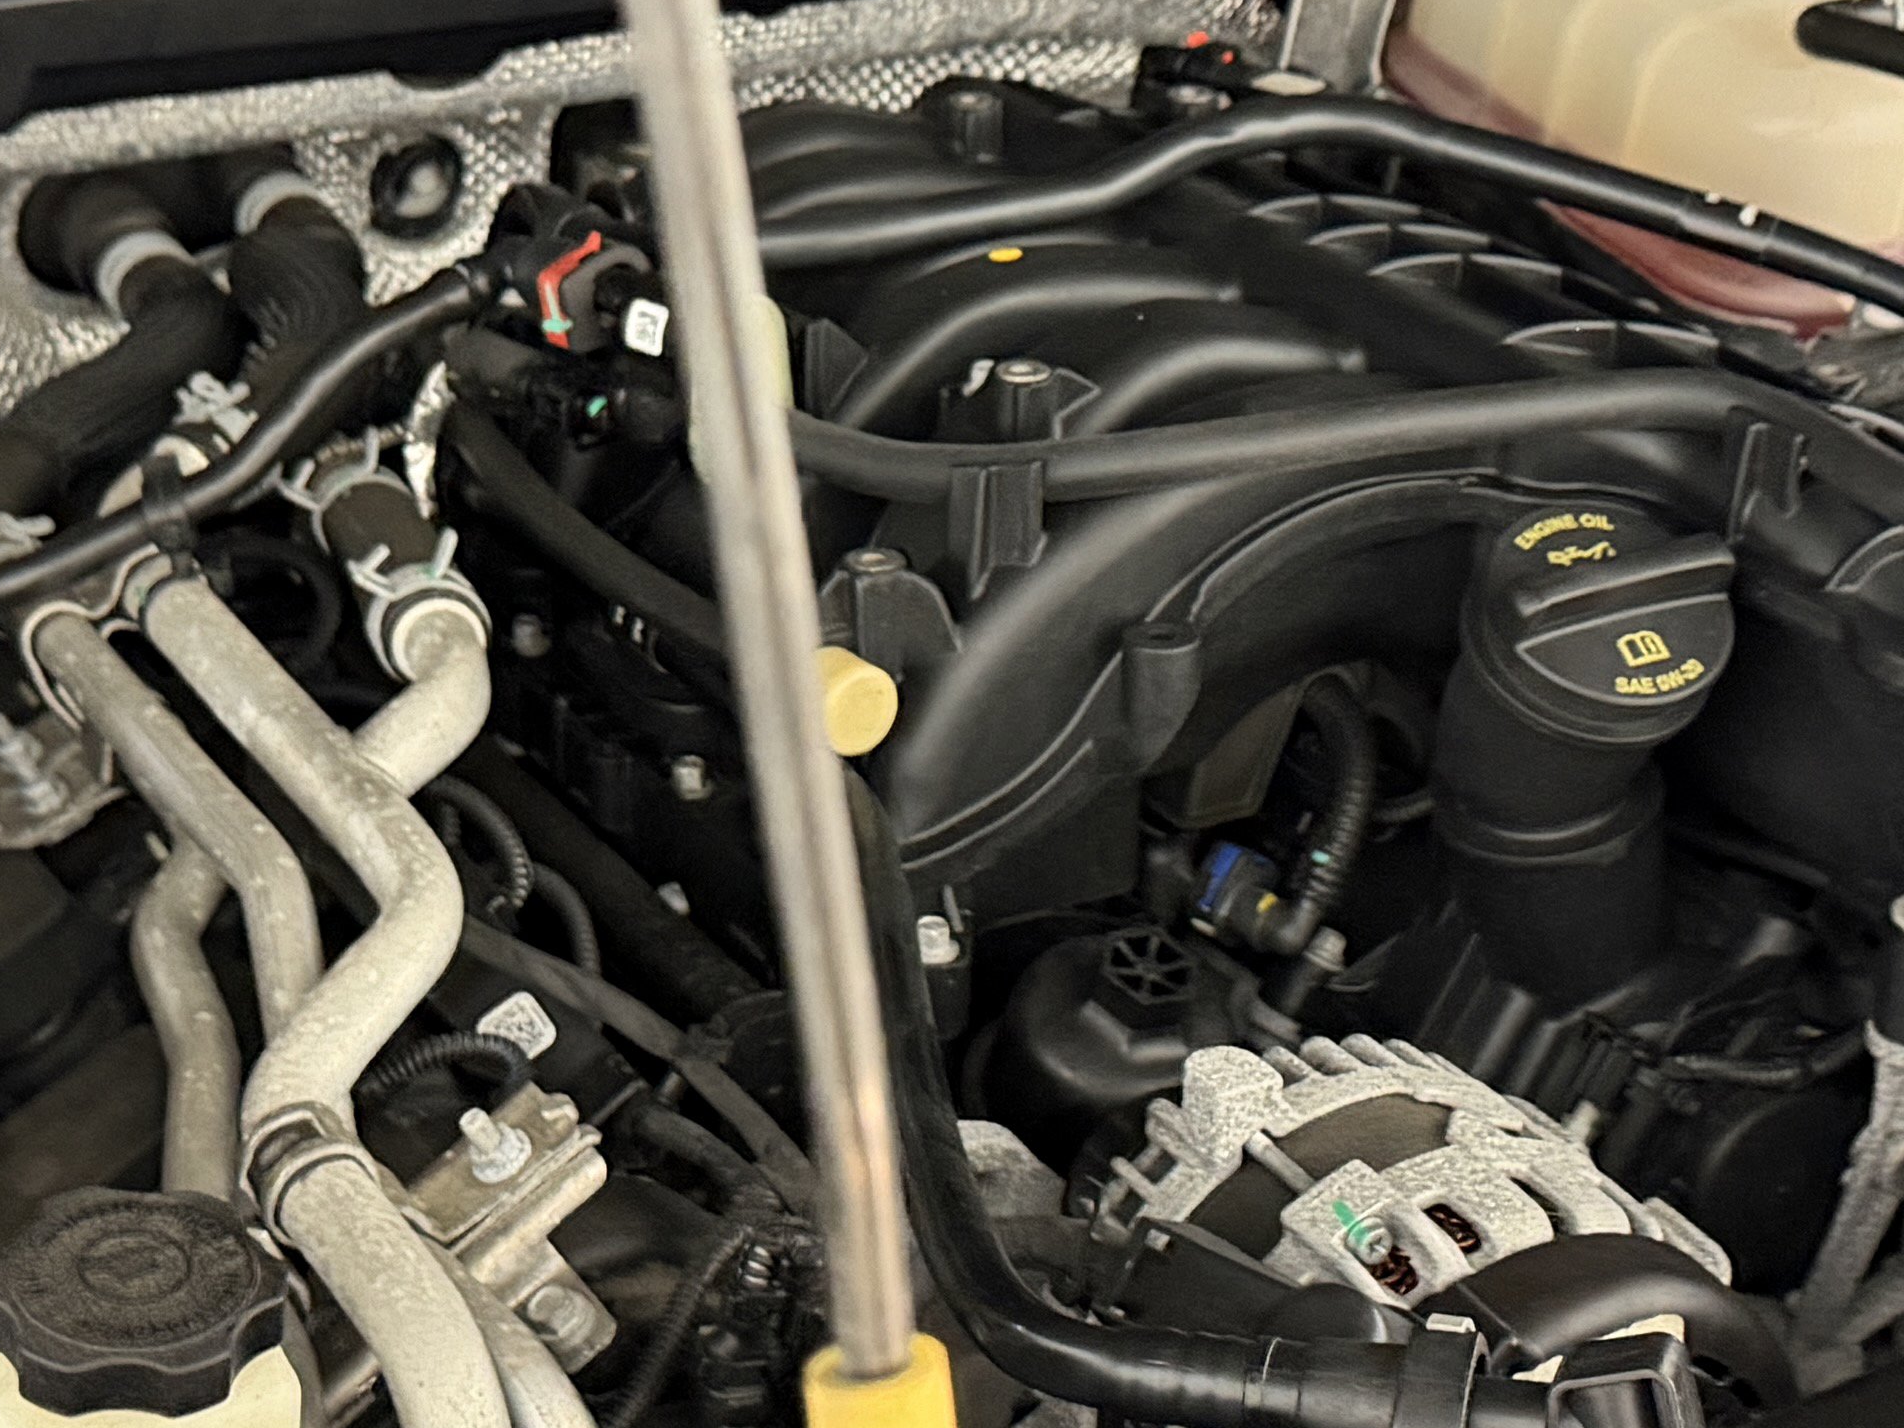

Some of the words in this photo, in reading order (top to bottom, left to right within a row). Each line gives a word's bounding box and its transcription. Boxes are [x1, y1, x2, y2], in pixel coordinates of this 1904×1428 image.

[1514, 513, 1580, 551] ENGINE
[1579, 513, 1615, 531] OIL
[1614, 676, 1657, 694] SAE
